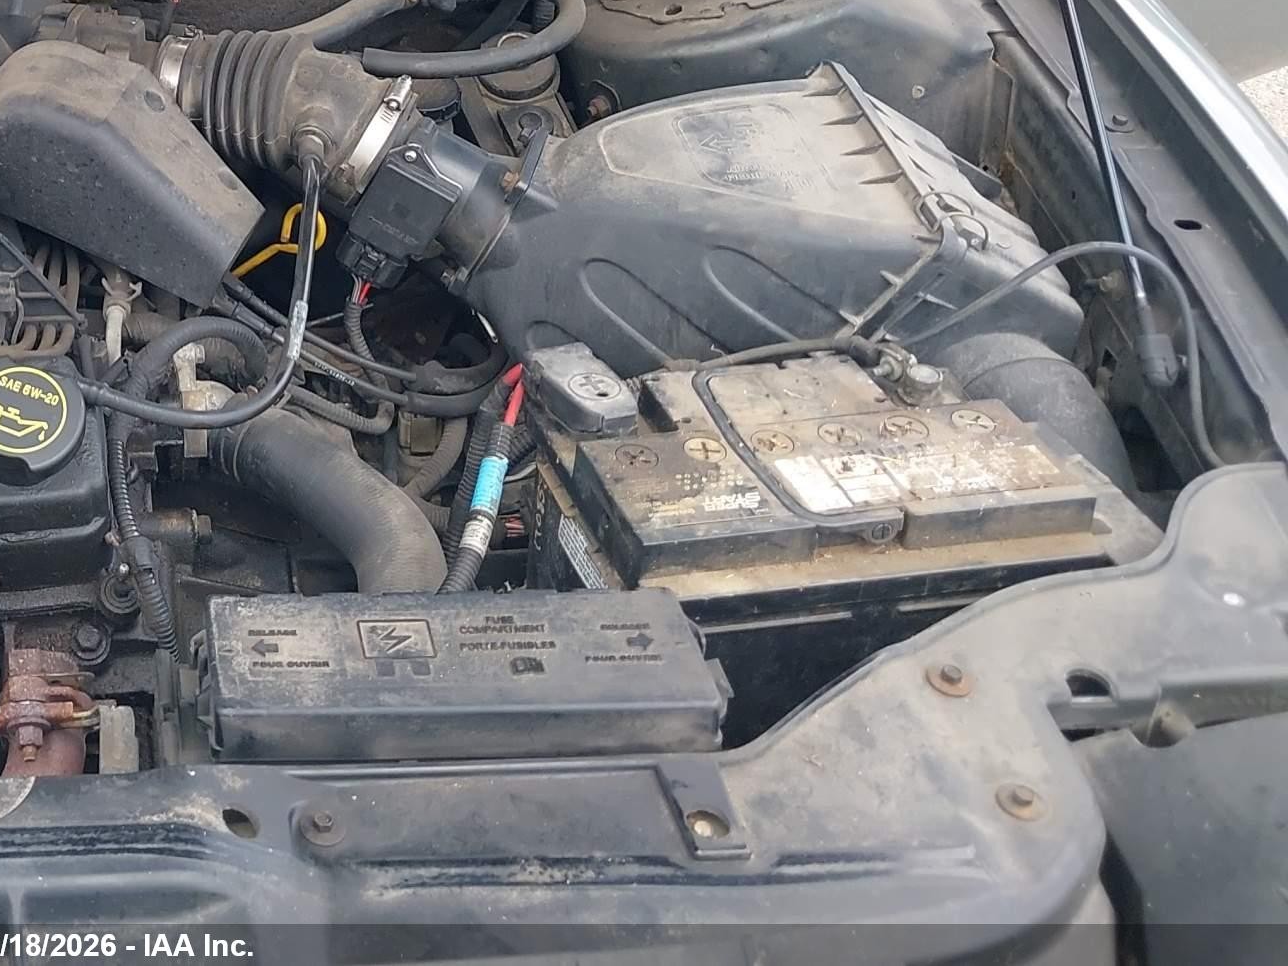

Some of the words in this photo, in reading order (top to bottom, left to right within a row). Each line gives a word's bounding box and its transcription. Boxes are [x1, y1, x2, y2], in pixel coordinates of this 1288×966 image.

[485, 615, 514, 624] FUSE
[459, 624, 545, 634] COMPARTMENT
[286, 660, 330, 668] OUVRIR
